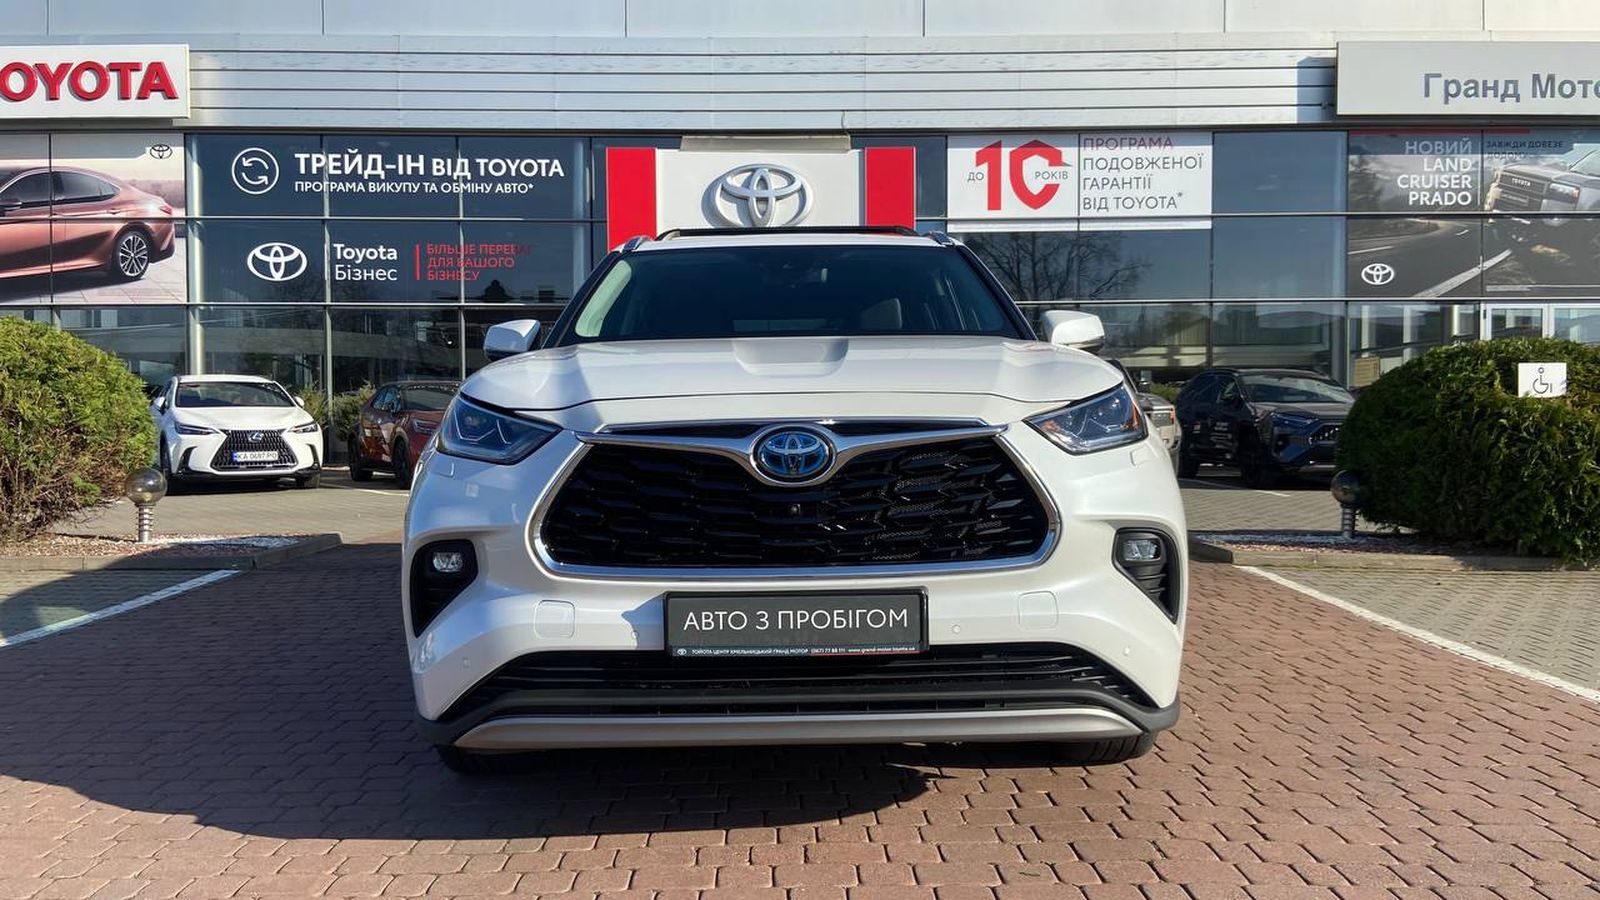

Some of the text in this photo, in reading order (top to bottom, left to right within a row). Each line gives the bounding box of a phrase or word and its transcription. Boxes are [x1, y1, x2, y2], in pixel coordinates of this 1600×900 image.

[0, 61, 179, 101] OYOTA
[1424, 73, 1600, 104] Гранд Мото
[1083, 136, 1174, 150] ПРОГРАМА
[1405, 137, 1472, 154] НОВИЙ
[294, 148, 565, 180] ТРЕЙД-ІН ВІД TOYOTA
[1083, 152, 1205, 173] ПОДОВЖЕНОЇ
[1423, 157, 1472, 172] LAND
[967, 171, 985, 181] ДО
[1034, 171, 1069, 181] РОКІВ
[1083, 173, 1153, 190] ГАРАНТІЇ
[1397, 174, 1472, 189] CRUISER
[294, 181, 366, 193] ПРОГРАМА
[368, 182, 421, 194] ВИКУПУ
[423, 182, 438, 193] ТА
[440, 182, 493, 194] ОБМІНУ
[1083, 197, 1109, 212] ВІД
[1409, 191, 1472, 206] PRADO
[333, 243, 398, 264] Toyota
[427, 243, 477, 255] БІЛЬШЕ
[427, 257, 515, 269] ДЛЯ ВАШОГО
[335, 264, 398, 281] Бізнес
[427, 270, 480, 281] БІЗНЕСУ
[683, 611, 748, 631] АВТО
[778, 608, 908, 630] ПРОБІГОМ
